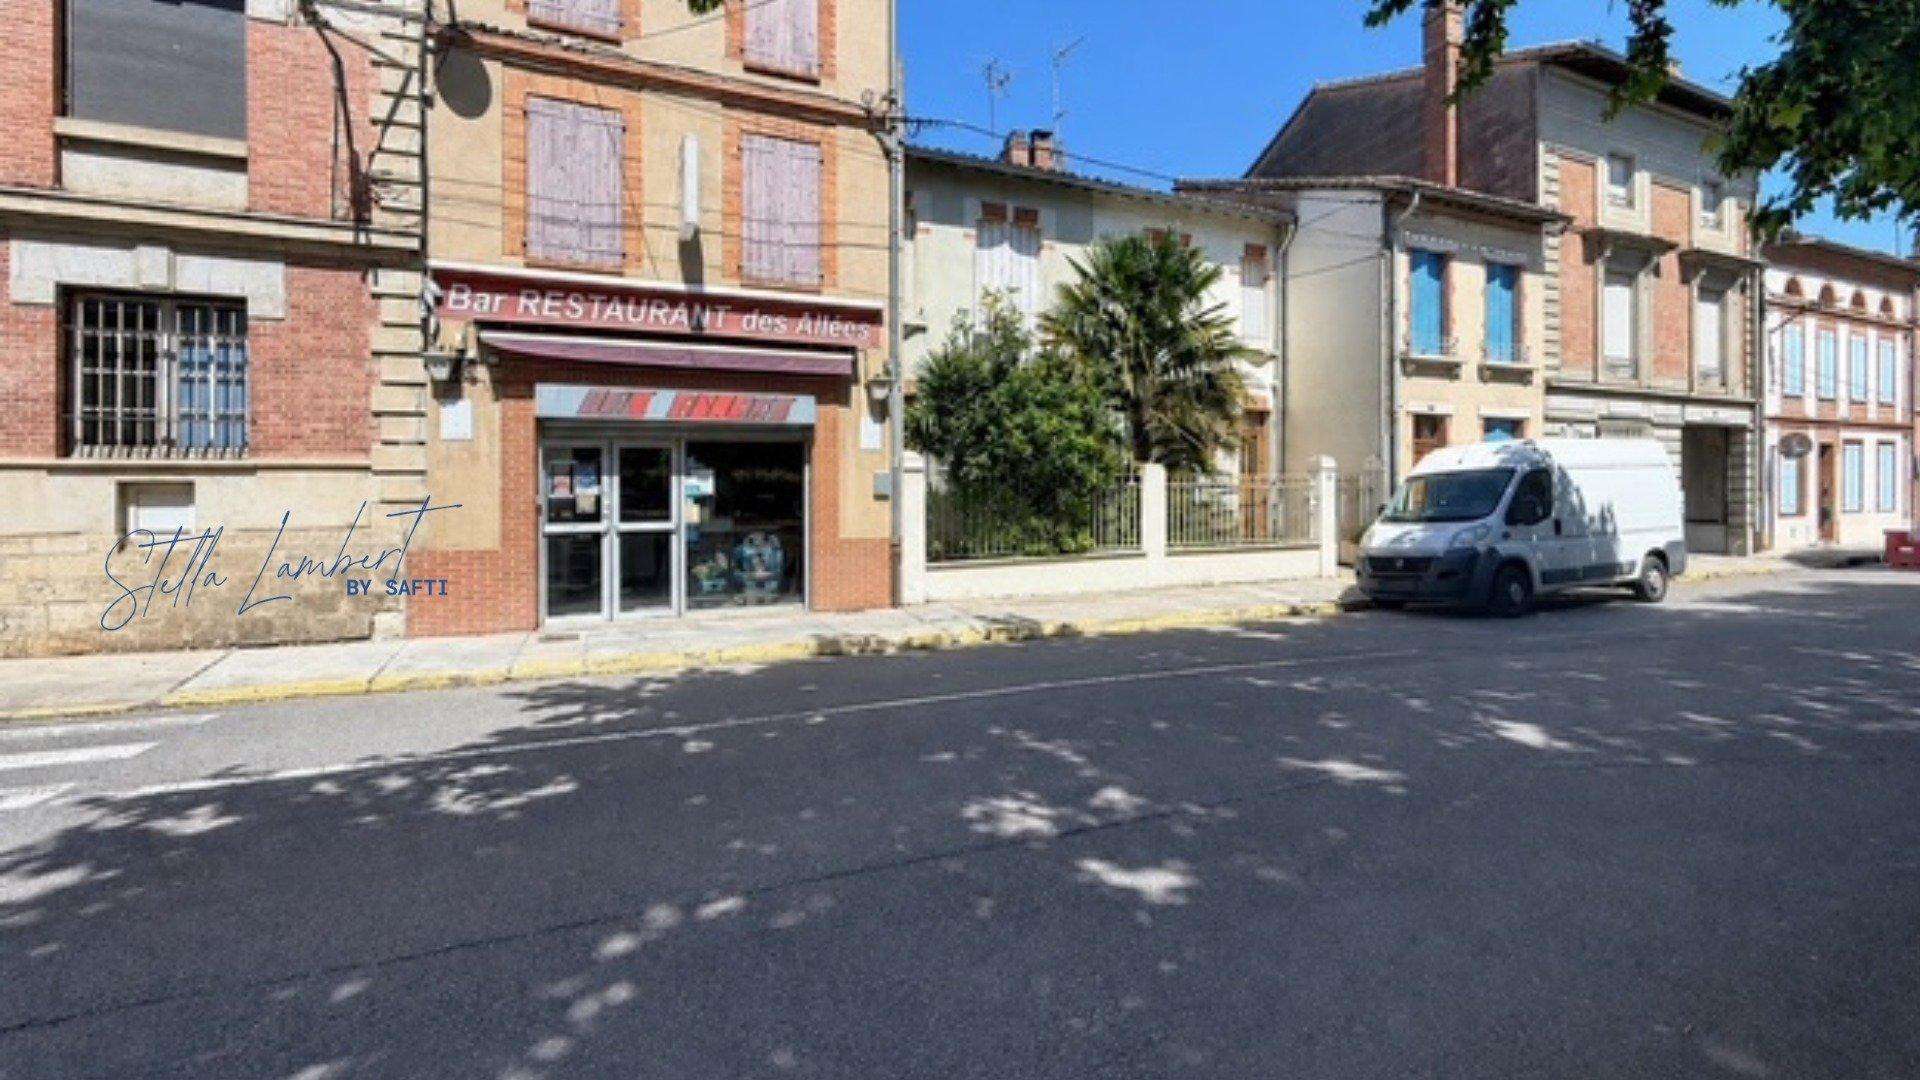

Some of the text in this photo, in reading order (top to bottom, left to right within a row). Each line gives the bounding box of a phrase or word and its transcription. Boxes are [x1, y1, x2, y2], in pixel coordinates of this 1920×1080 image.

[448, 283, 508, 313] Bar
[517, 288, 732, 333] RESTAURANT
[741, 308, 788, 335] des
